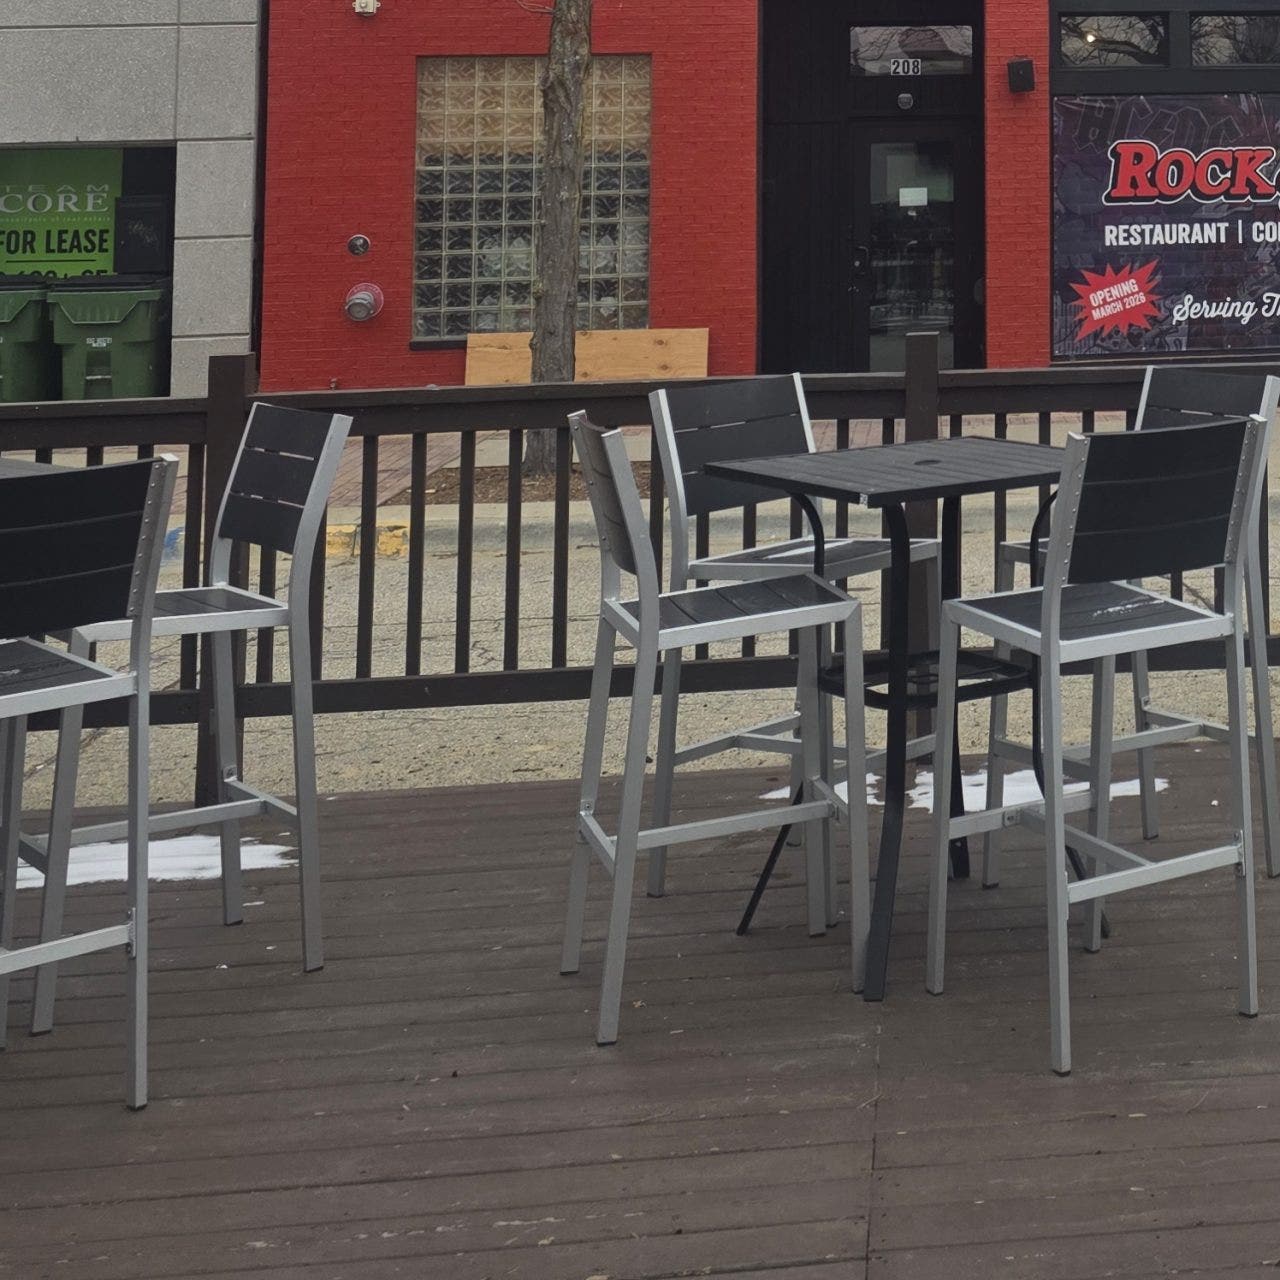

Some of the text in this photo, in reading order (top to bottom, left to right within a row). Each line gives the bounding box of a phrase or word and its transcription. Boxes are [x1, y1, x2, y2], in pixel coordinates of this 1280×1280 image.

[891, 59, 921, 75] 208
[1104, 140, 1277, 204] ROCK
[0, 192, 109, 213] CORE
[45, 228, 110, 254] LEASE
[1104, 222, 1229, 246] RESTAURANT
[1089, 278, 1139, 307] OPENING
[1091, 292, 1146, 321] MARCH 2026
[1172, 293, 1258, 326] Serving
